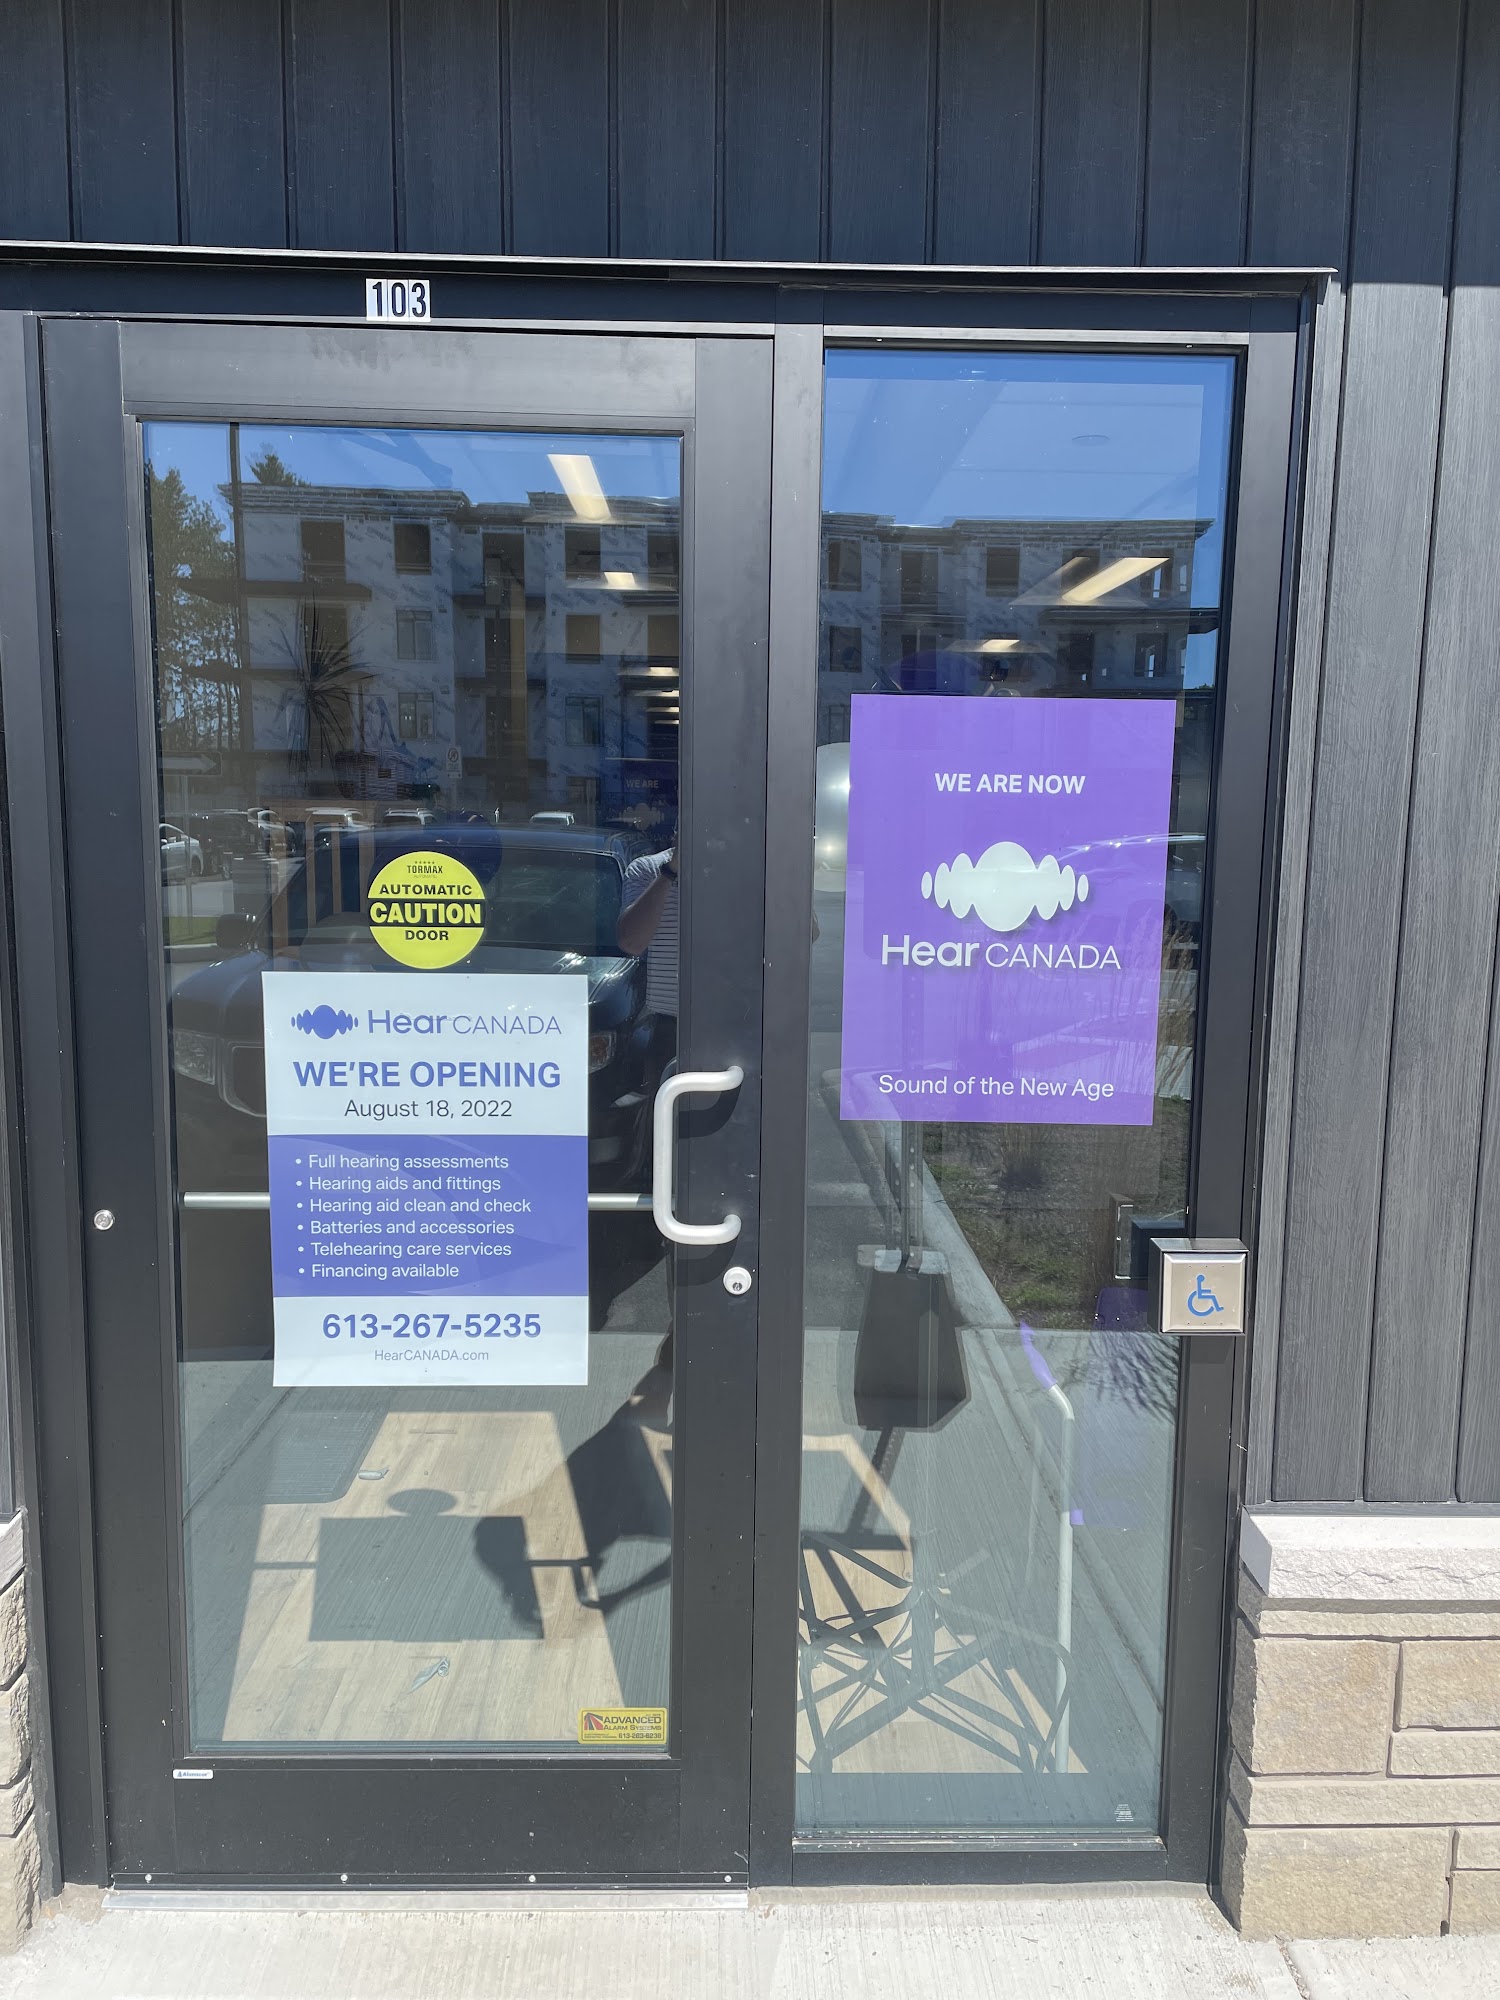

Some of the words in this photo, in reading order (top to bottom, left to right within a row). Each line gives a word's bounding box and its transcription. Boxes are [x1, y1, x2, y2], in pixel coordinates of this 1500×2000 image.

[372, 281, 427, 317] 103
[642, 780, 659, 788] ARE
[935, 773, 971, 792] WE
[976, 774, 1022, 793] ARE
[1028, 775, 1086, 794] NOW
[407, 865, 443, 874] TORMAX
[379, 884, 473, 895] AUTOMATIC
[370, 902, 481, 924] CAUTION
[405, 930, 449, 941] DOOR
[293, 1061, 400, 1087] WE'RE
[410, 1061, 561, 1088] OPENING
[878, 1074, 947, 1095] Sound
[953, 1076, 975, 1095] of
[980, 1077, 1014, 1096] the
[1020, 1078, 1067, 1097] New
[1072, 1080, 1114, 1101] Age
[344, 1099, 418, 1121] August
[426, 1100, 454, 1119] 18,
[461, 1100, 512, 1117] 2022
[308, 1154, 336, 1168] Full
[340, 1154, 399, 1171] hearing
[403, 1155, 509, 1169] assessments
[309, 1176, 371, 1193] Hearing
[375, 1176, 408, 1190] aids
[412, 1176, 442, 1190] and
[446, 1176, 501, 1193] fittings
[310, 1198, 372, 1215] Hearing
[376, 1198, 399, 1212] aid
[404, 1198, 446, 1212] clean
[450, 1198, 479, 1212] and
[484, 1198, 531, 1212] check
[310, 1220, 382, 1234] Batteries
[386, 1220, 415, 1234] and
[420, 1220, 514, 1234] accessories
[311, 1242, 402, 1259] Telehearing
[406, 1245, 441, 1256] care
[445, 1242, 511, 1256] services
[312, 1263, 387, 1280] Financing
[392, 1263, 459, 1277] available
[323, 1313, 541, 1339] 613-267-5235
[374, 1349, 489, 1361] HearCANADA.com
[603, 1716, 661, 1724] ADVANCED
